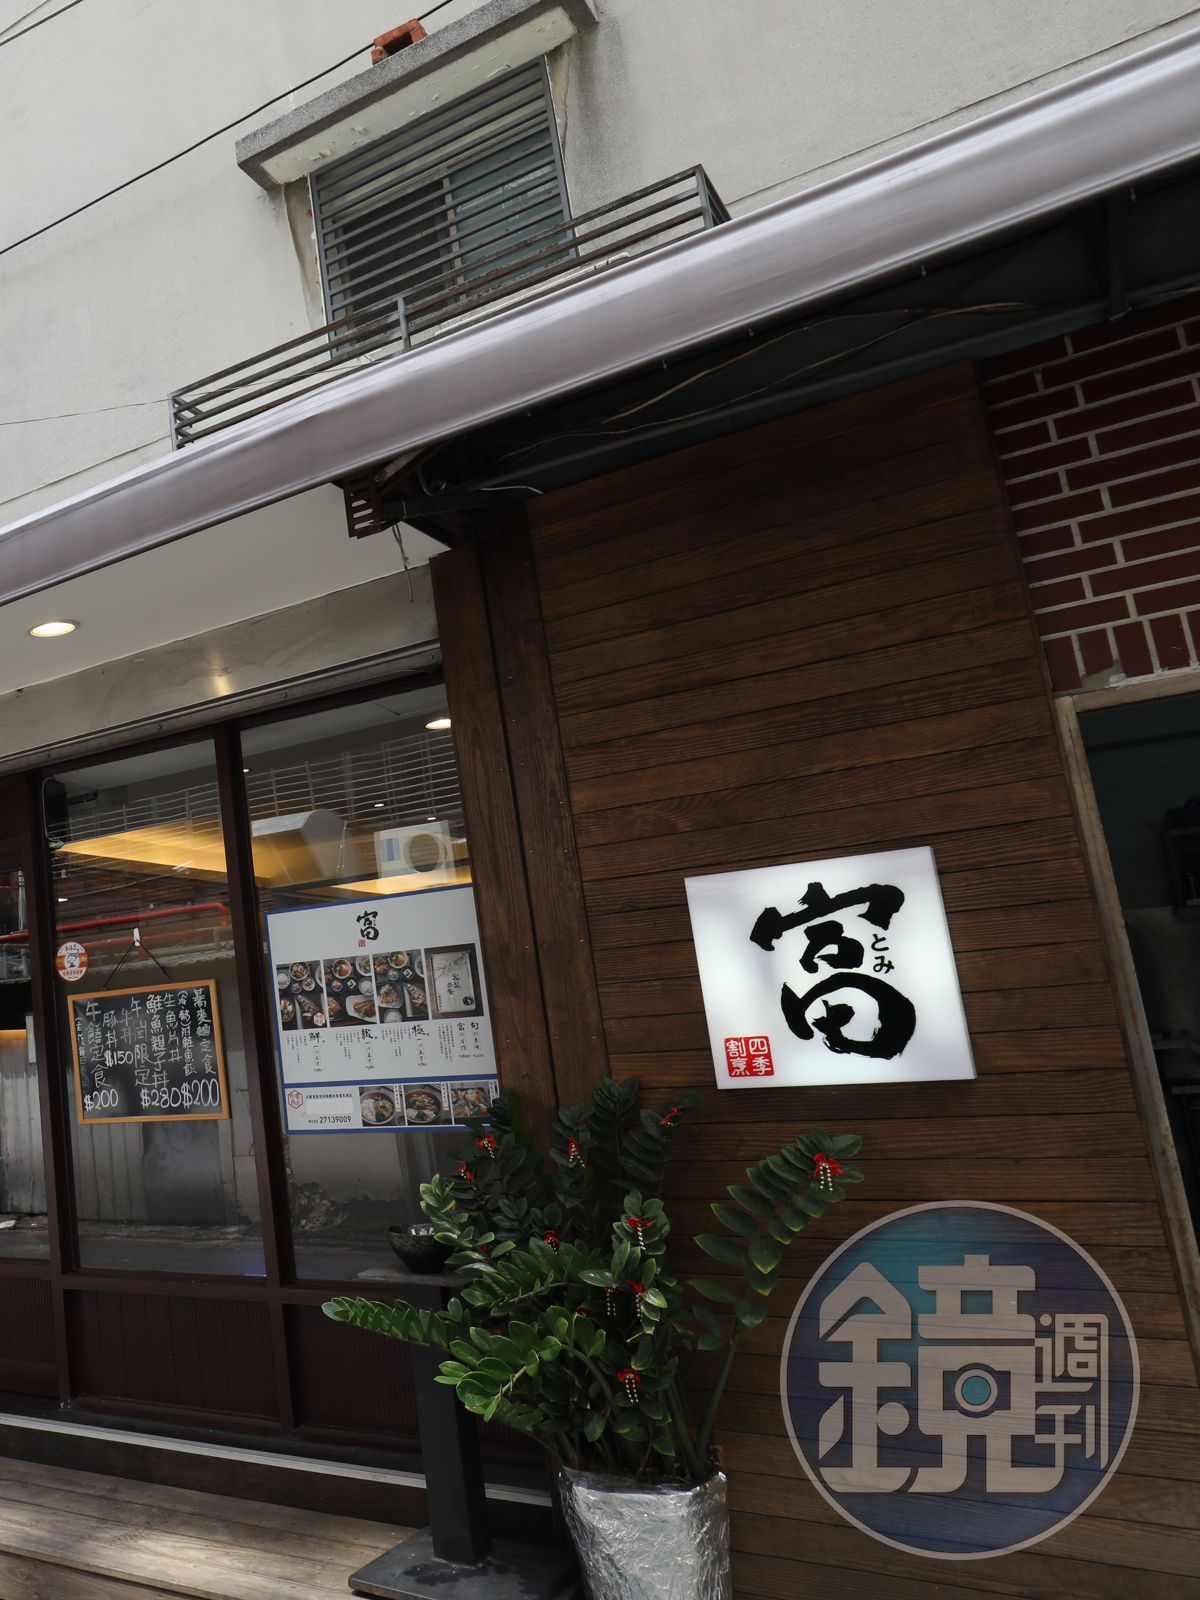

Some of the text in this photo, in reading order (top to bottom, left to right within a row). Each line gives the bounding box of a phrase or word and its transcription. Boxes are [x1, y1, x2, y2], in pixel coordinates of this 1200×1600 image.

[356, 910, 380, 940] 富
[748, 881, 918, 1060] 富
[871, 931, 895, 974] とみ
[102, 1008, 134, 1068] 牛丼 豚丼 $150
[140, 992, 183, 1109] 生魚片丼 鮭魚親子丼 $280
[726, 1037, 748, 1076] 割烹
[750, 1037, 773, 1076] 四季
[84, 1088, 119, 1112] $200
[181, 1078, 219, 1109] $200
[319, 1115, 352, 1125] 27139009
